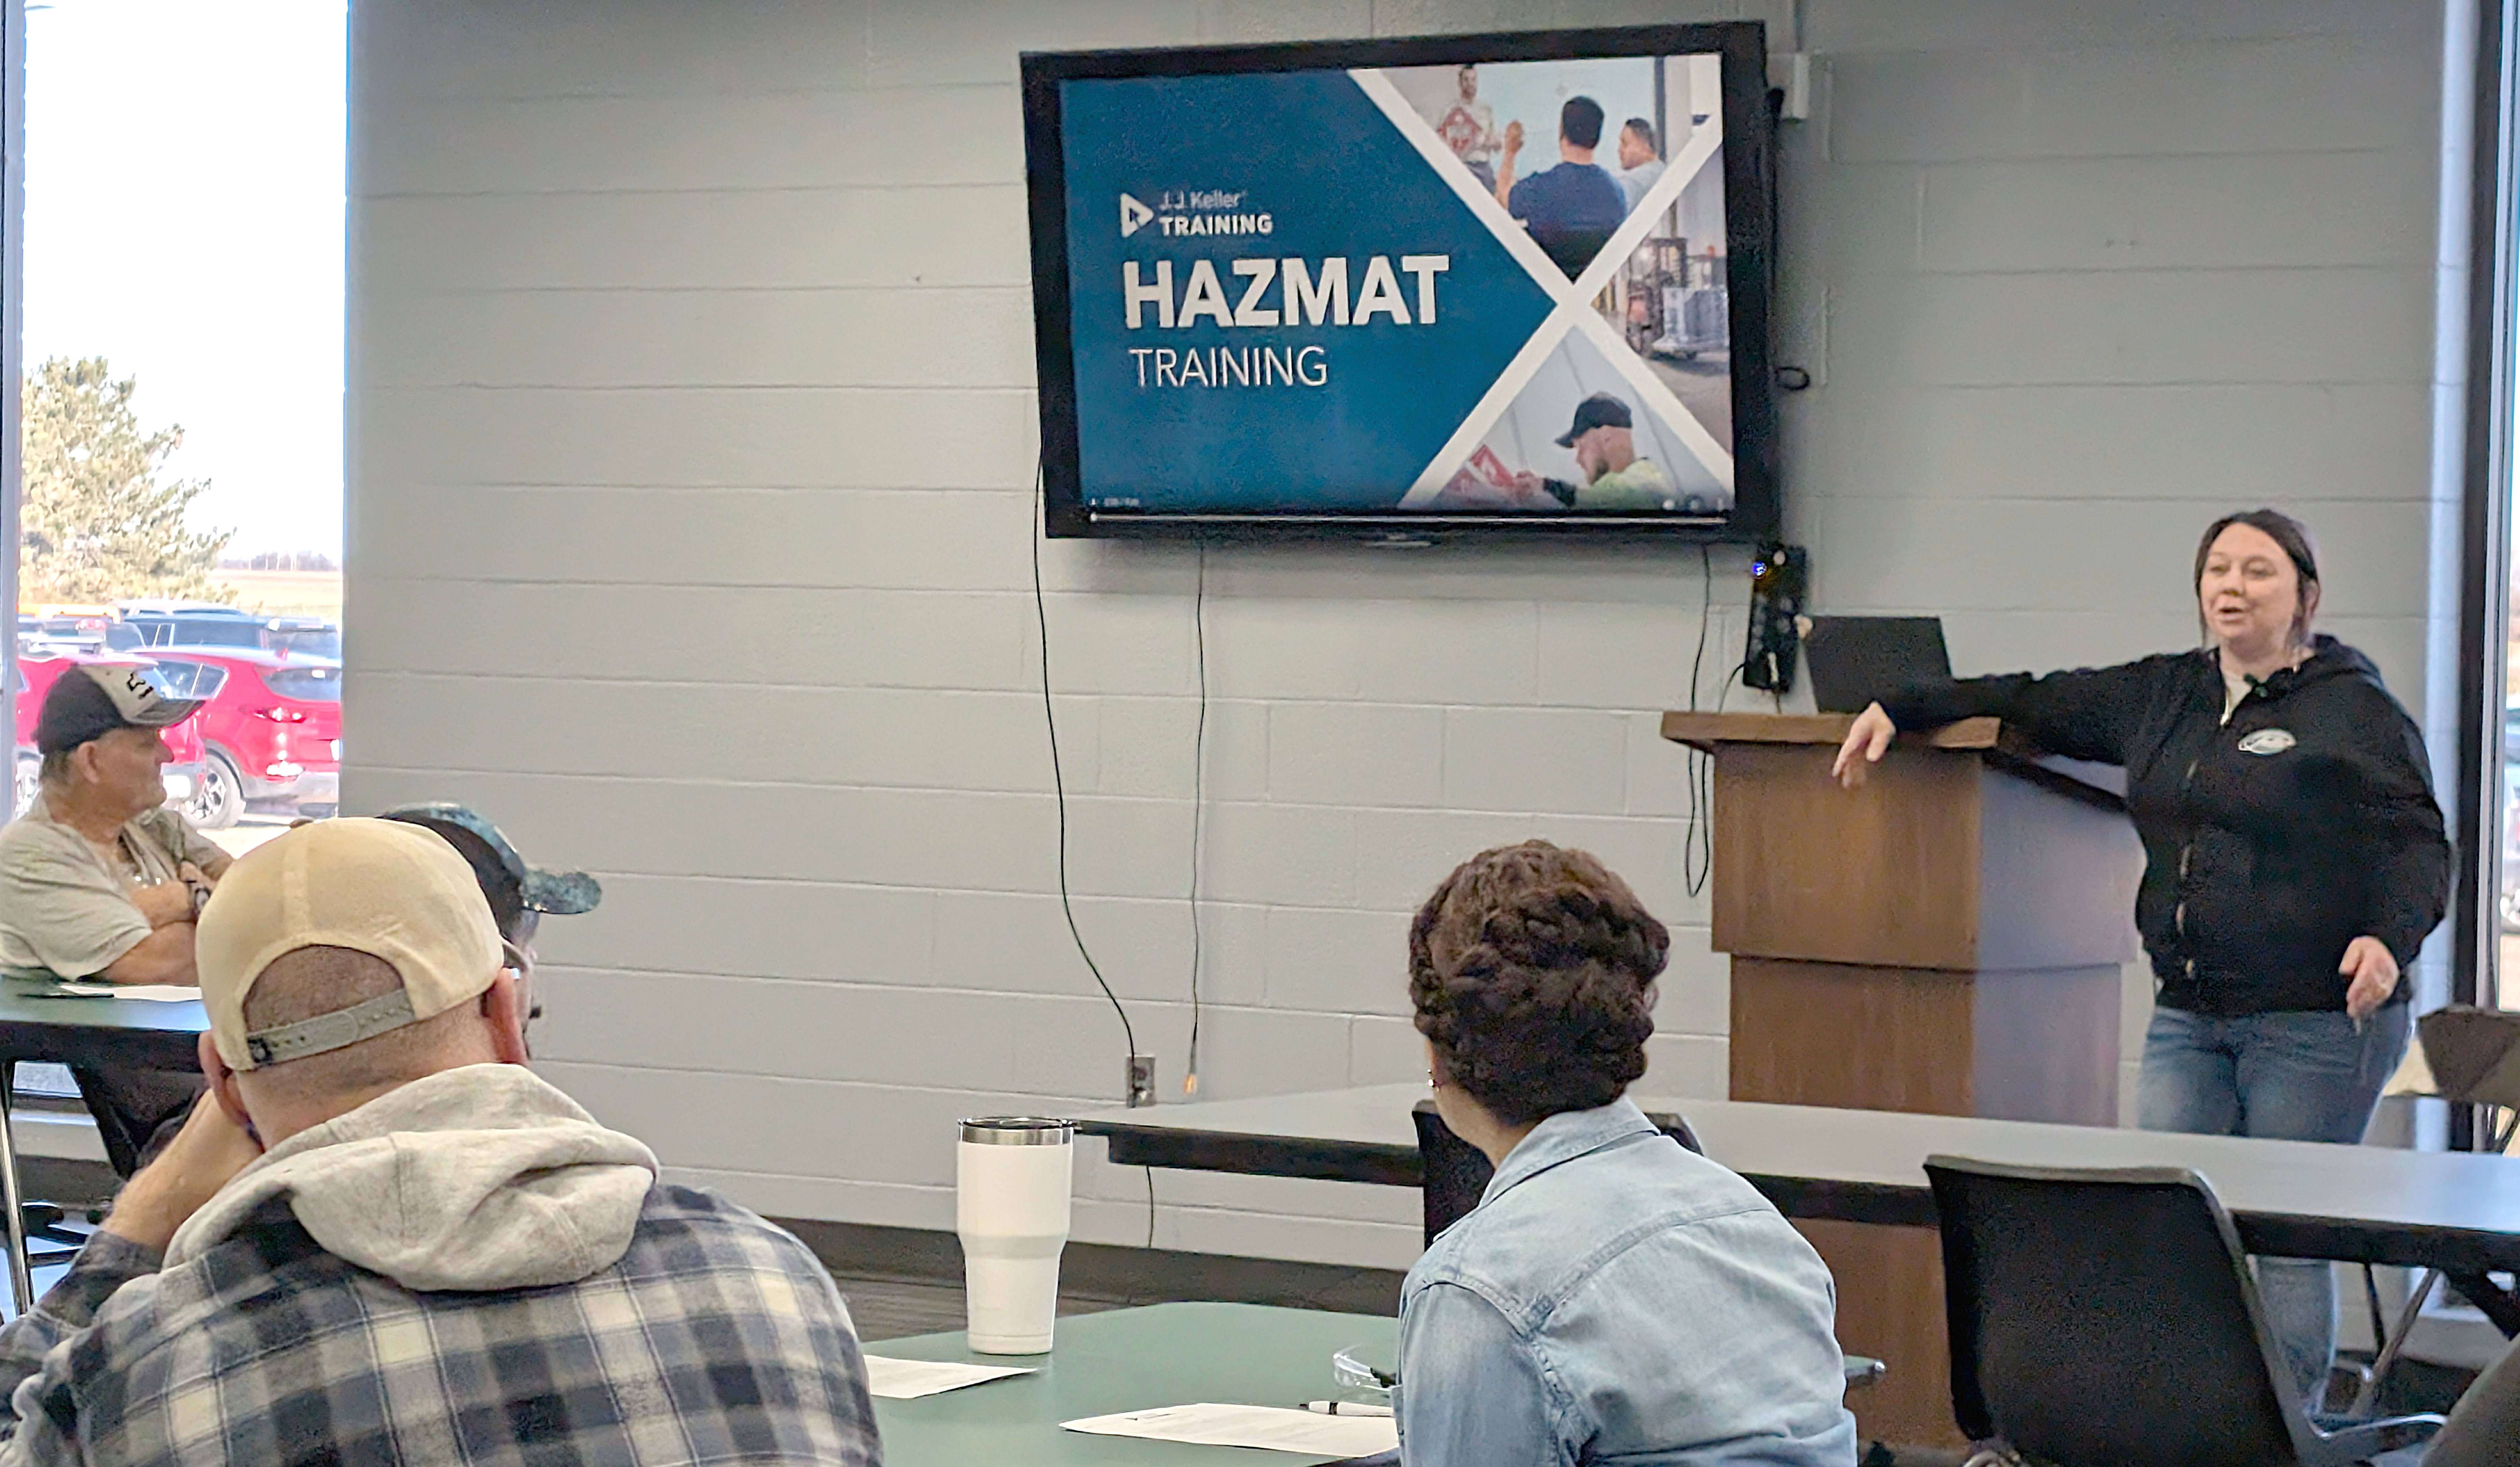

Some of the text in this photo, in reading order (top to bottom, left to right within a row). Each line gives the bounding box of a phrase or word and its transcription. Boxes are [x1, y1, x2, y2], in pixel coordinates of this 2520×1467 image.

[1158, 213, 1273, 236] TRAINING
[1123, 254, 1450, 329] HAZMAT
[1129, 345, 1328, 388] TRAINING
